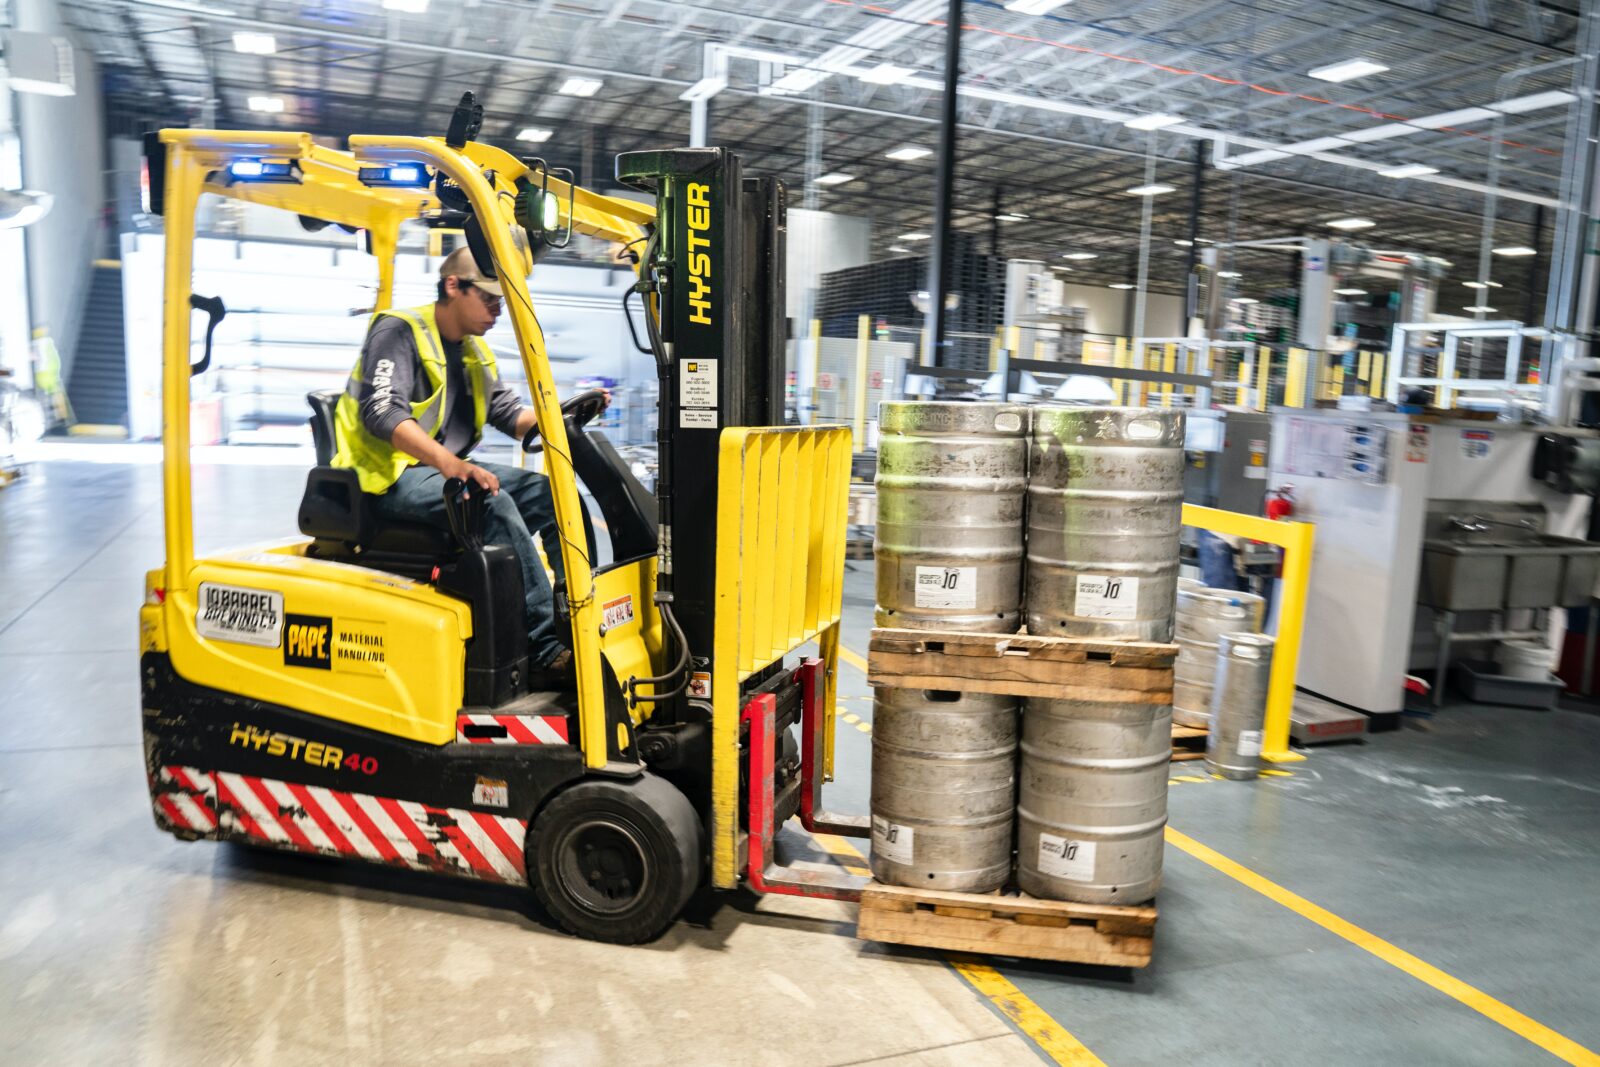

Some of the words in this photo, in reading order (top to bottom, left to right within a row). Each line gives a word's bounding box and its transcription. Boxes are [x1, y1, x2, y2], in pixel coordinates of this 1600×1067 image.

[687, 182, 712, 325] HYSTER
[941, 571, 958, 590] 10
[1103, 581, 1120, 599] 10
[339, 632, 384, 647] MATERIAL
[337, 648, 385, 662] HANDLING
[230, 722, 344, 770] HYSTER
[344, 753, 379, 775] 40
